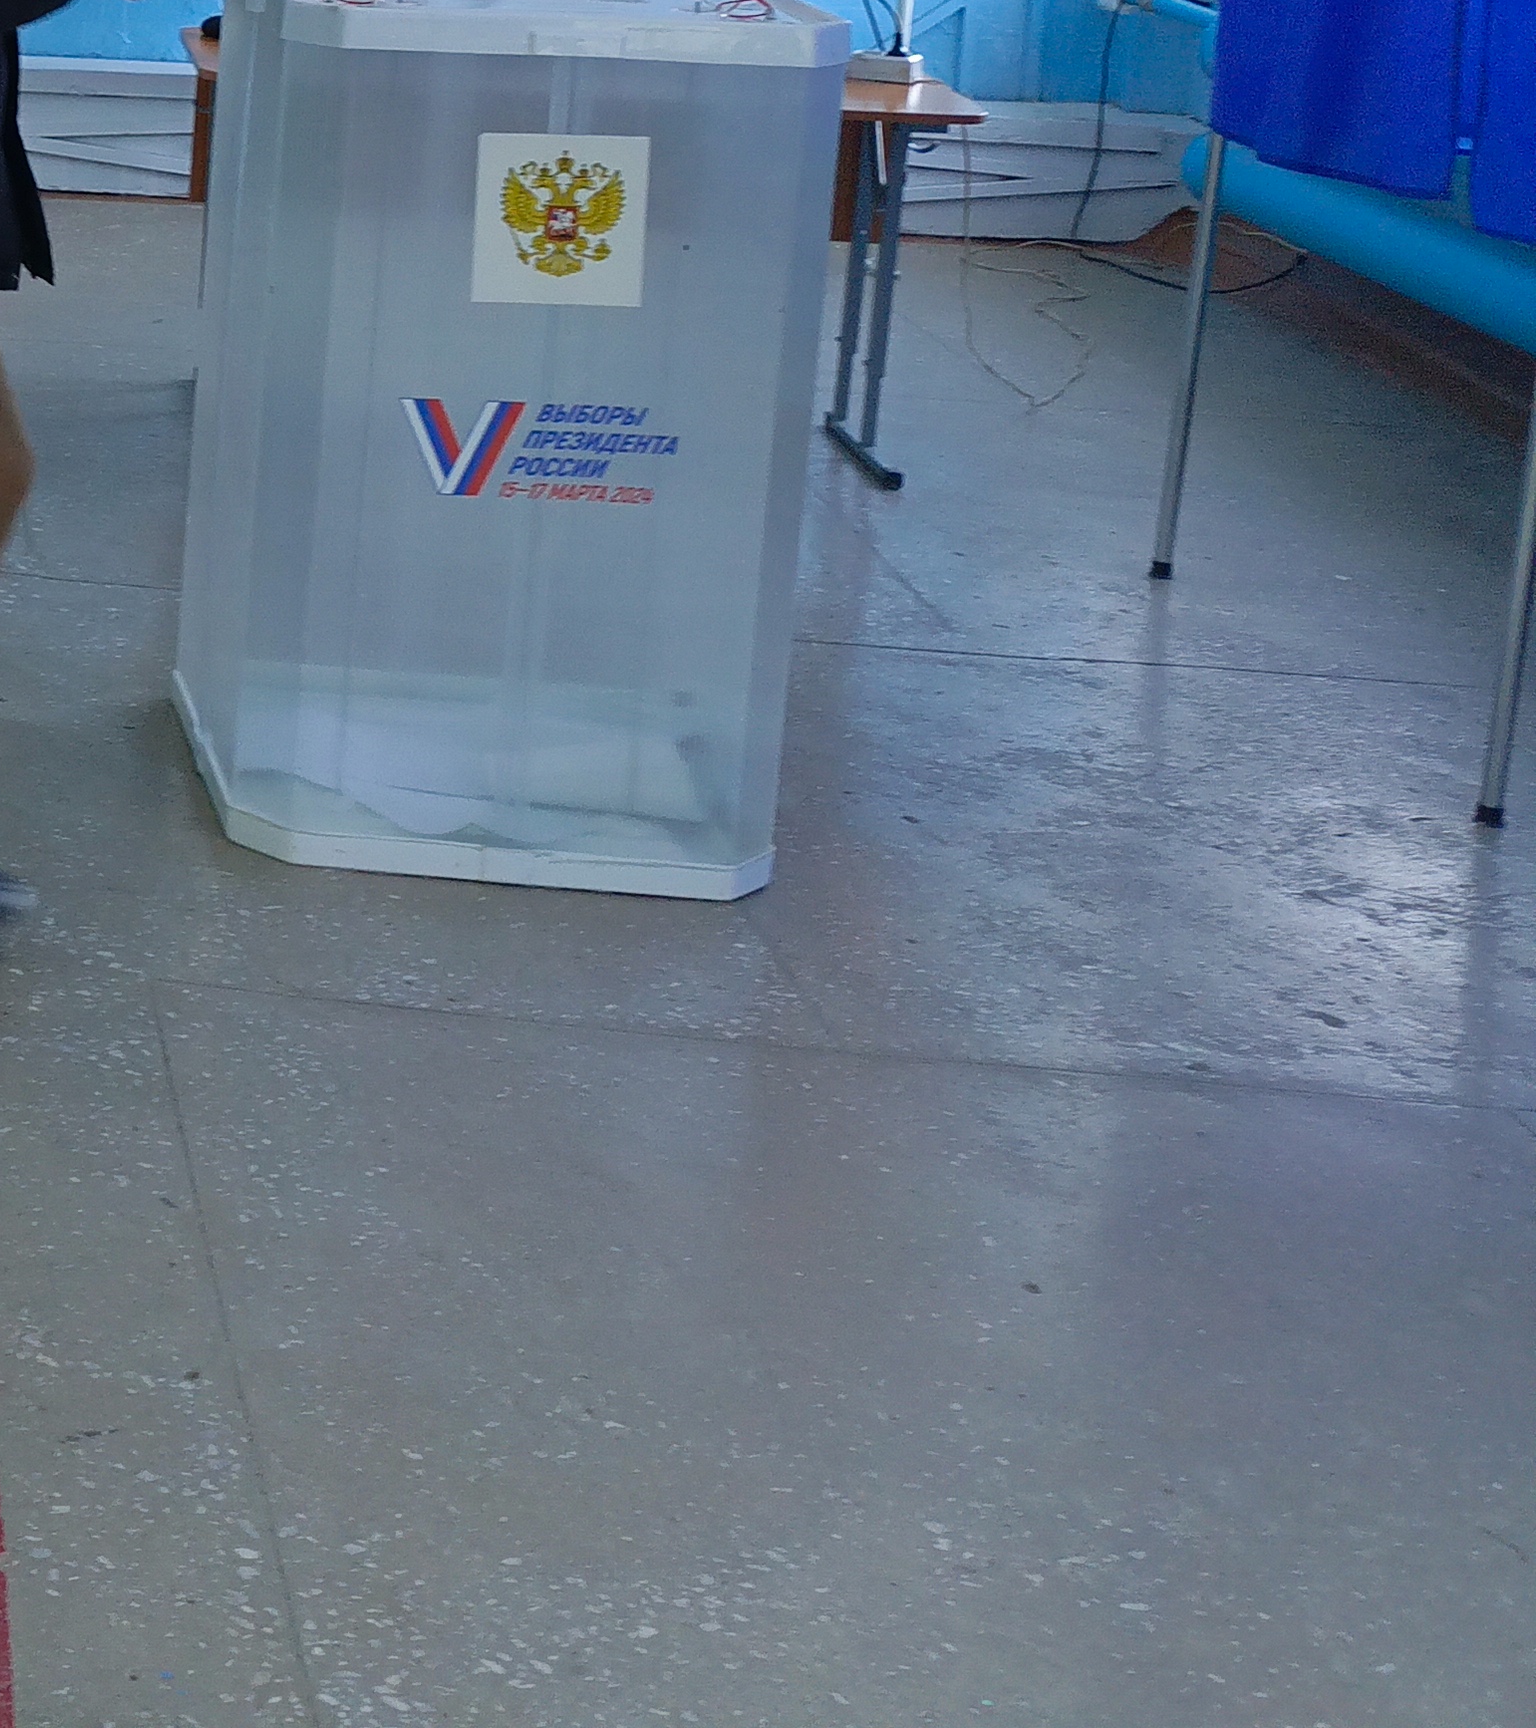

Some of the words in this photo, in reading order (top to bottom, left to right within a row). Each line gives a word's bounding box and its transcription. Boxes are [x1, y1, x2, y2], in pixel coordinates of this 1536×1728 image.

[535, 404, 649, 426] ВЫБОРЫ
[523, 430, 679, 455] ПРЕЗИДЕНТА
[508, 456, 610, 478] РОССИИ
[547, 484, 609, 502] МАРТА
